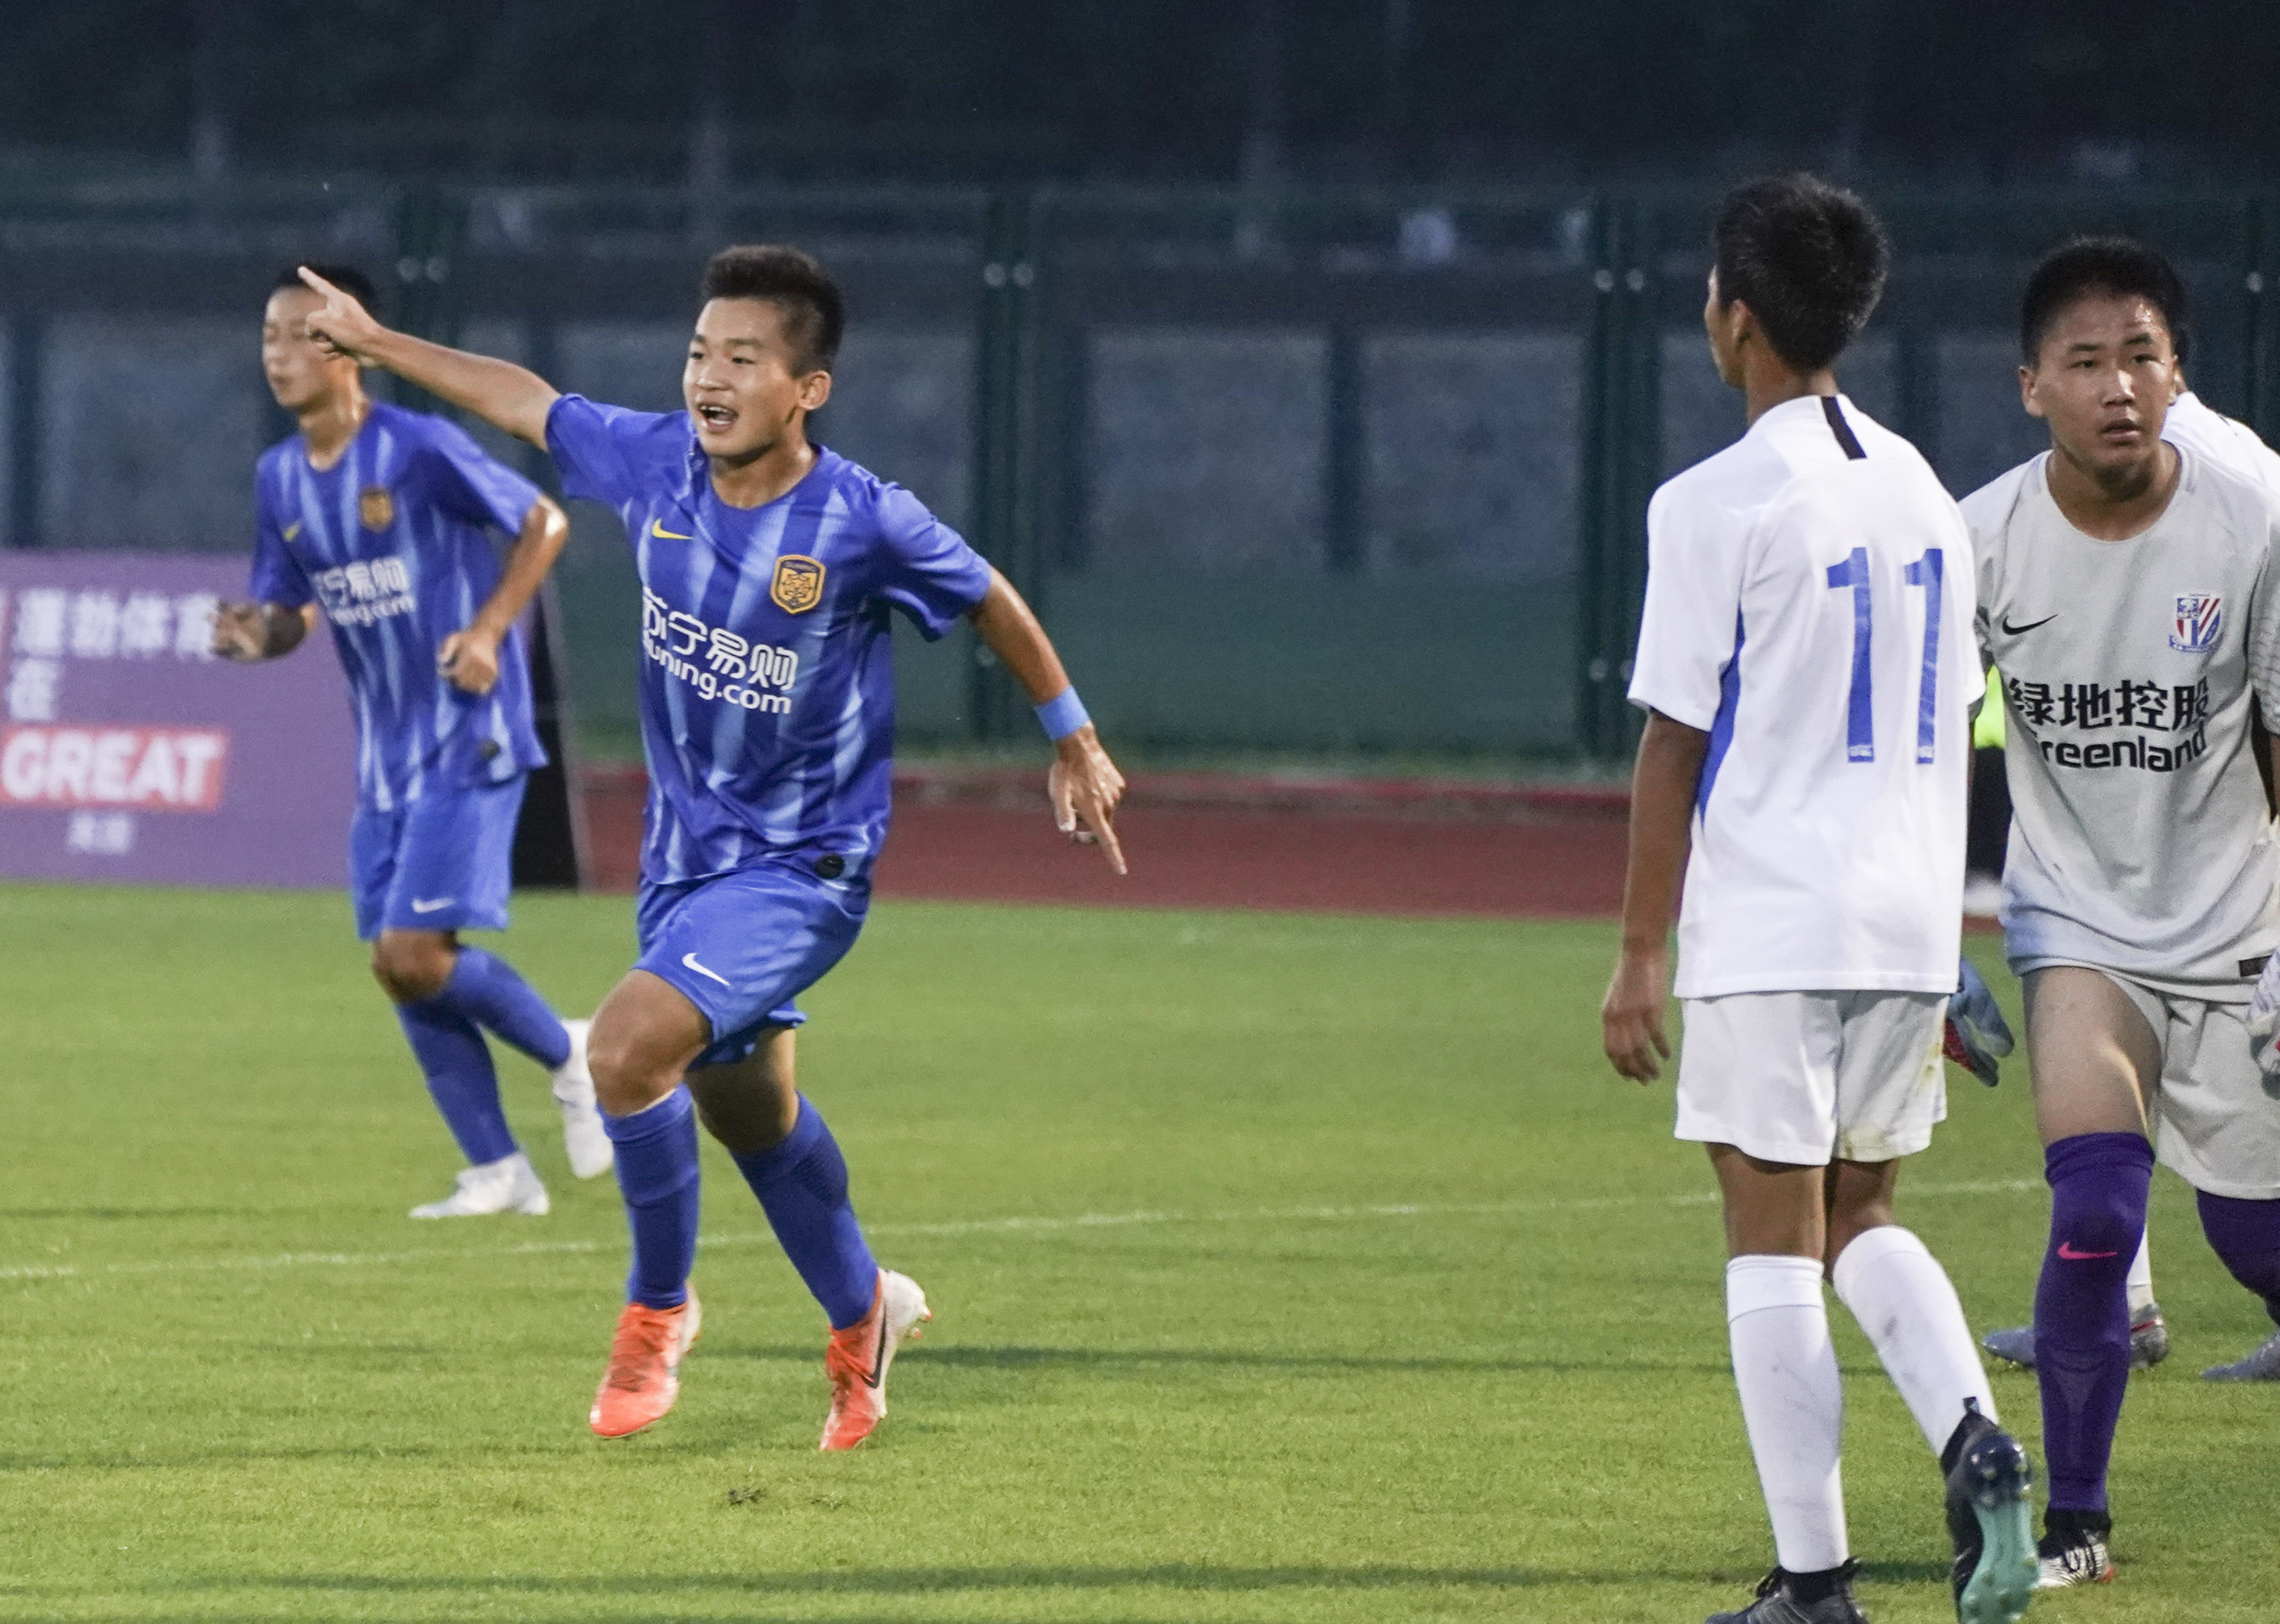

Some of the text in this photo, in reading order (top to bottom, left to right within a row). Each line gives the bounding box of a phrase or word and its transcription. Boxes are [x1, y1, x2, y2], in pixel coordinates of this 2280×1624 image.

[1827, 547, 1943, 764] 11
[2008, 676, 2208, 731] 绿地控股
[1, 730, 222, 804] GREAT
[2026, 718, 2207, 772] reenland
